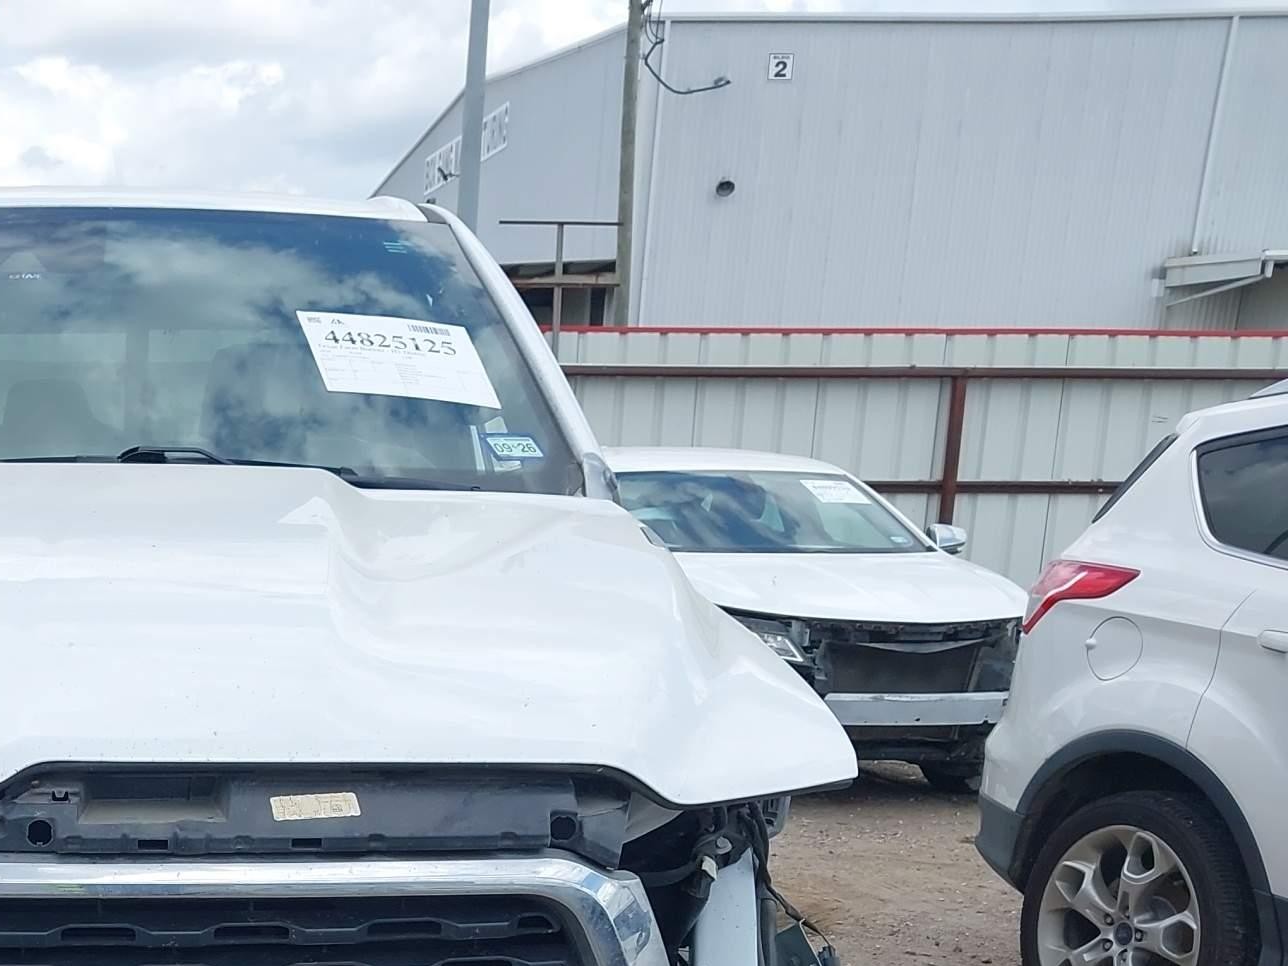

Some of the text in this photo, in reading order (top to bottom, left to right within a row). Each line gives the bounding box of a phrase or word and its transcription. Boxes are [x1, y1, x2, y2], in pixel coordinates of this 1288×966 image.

[774, 61, 787, 78] 2
[324, 329, 457, 356] 44825125
[493, 442, 513, 453] 09
